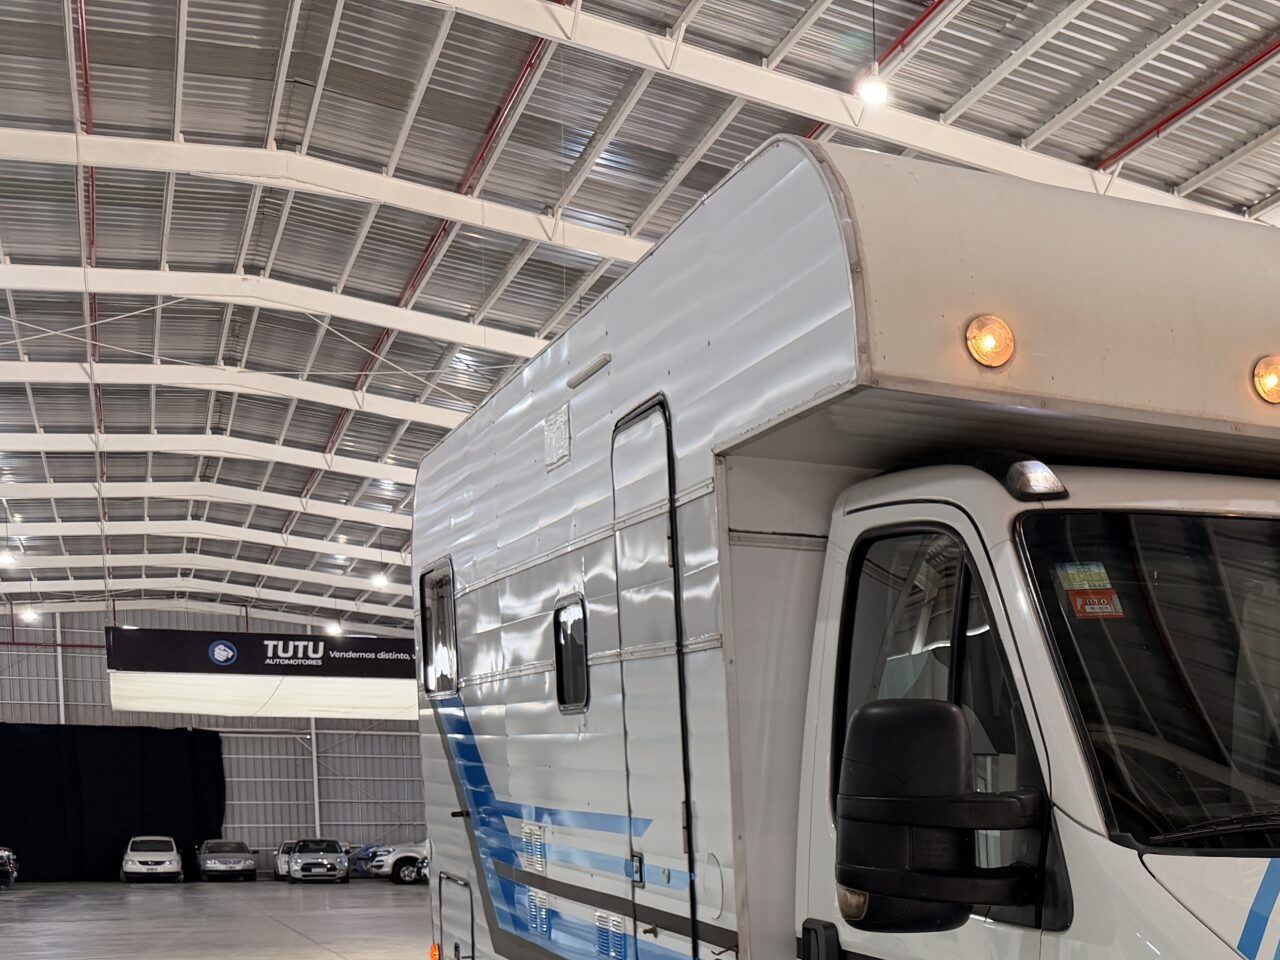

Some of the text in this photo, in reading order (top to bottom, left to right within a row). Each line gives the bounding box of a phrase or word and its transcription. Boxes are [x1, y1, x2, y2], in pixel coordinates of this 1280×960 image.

[263, 640, 325, 659] TUTU
[329, 650, 375, 659] Vendemos
[376, 651, 411, 661] distinto,
[264, 658, 323, 666] AUTOMOTORES
